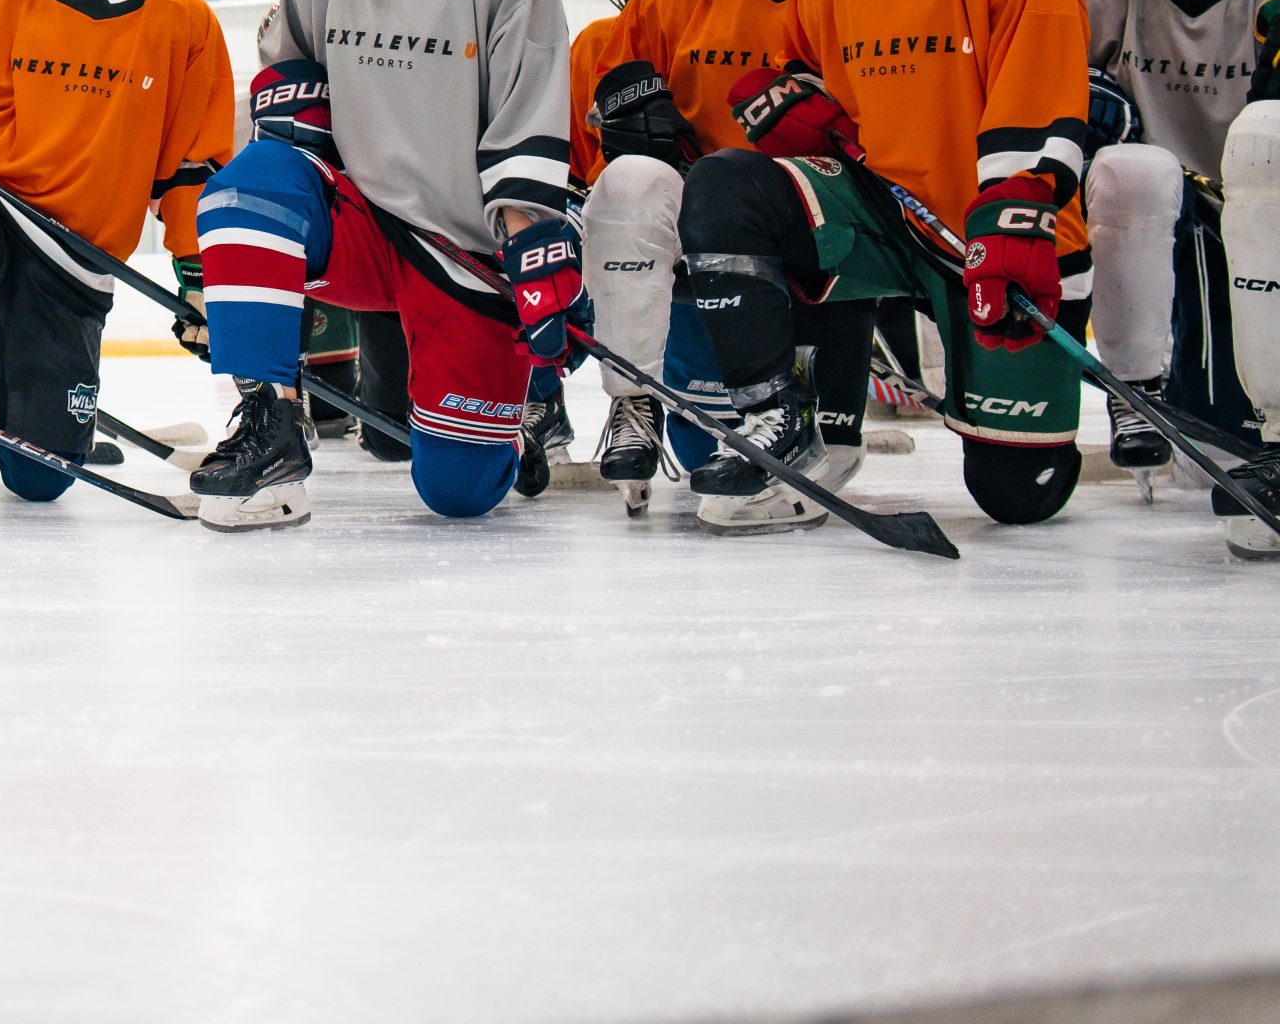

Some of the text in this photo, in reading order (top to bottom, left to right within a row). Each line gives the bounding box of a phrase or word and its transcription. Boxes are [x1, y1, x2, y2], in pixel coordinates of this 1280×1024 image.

[326, 28, 478, 60] EXT LEVEL U
[874, 35, 956, 57] LEVEL
[358, 55, 413, 70] SPORTS
[690, 49, 751, 66] NEXT
[1122, 51, 1251, 80] NXT LEVEL
[13, 57, 70, 76] NEXT
[141, 75, 154, 90] U
[861, 64, 916, 77] SPORTS
[64, 83, 112, 99] SPORTS
[255, 81, 331, 113] BAUE
[1166, 82, 1218, 96] SPORTS
[891, 185, 938, 224] CCM
[997, 207, 1057, 235] CC
[604, 259, 655, 272] CCM
[696, 294, 742, 310] CCM
[975, 283, 983, 313] CCM
[439, 392, 523, 420] BAUER
[965, 392, 1049, 418] CCM
[816, 411, 856, 426] CM
